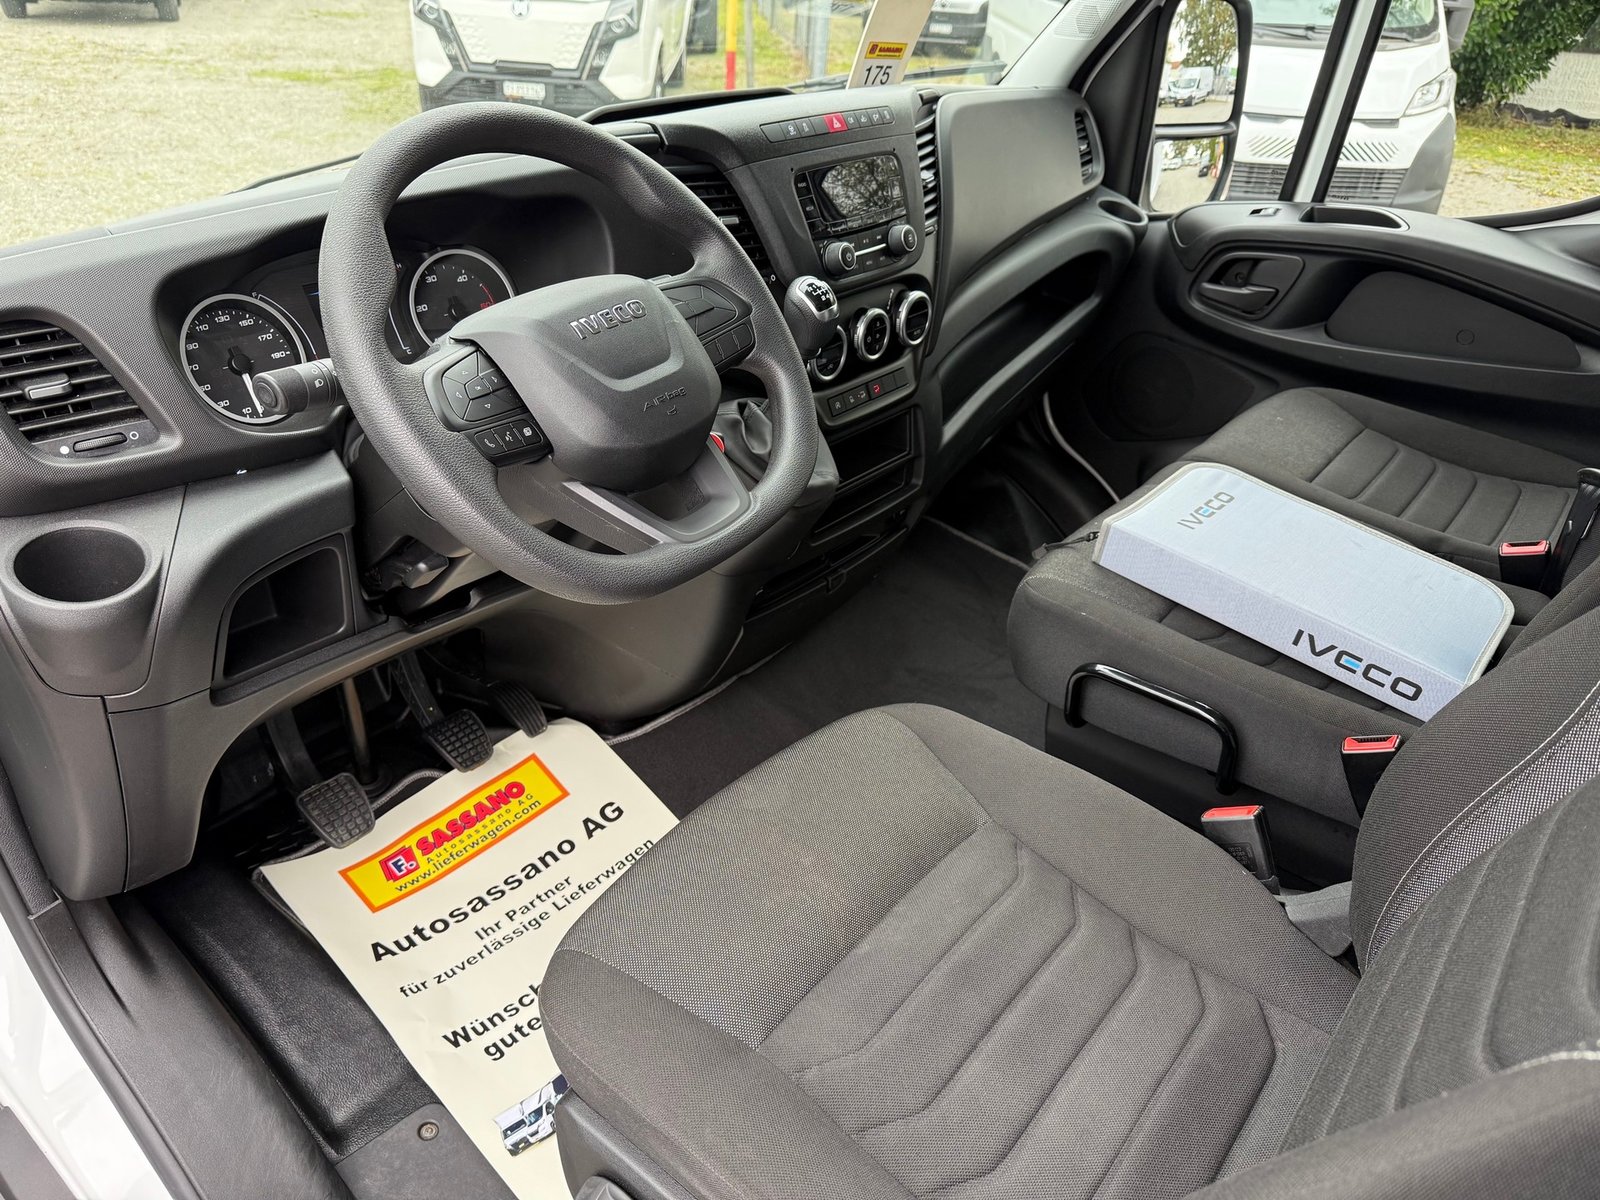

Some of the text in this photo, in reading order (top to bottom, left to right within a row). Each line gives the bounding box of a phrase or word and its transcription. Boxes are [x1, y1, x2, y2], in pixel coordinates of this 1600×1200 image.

[864, 65, 892, 85] 175
[425, 274, 437, 284] 30
[456, 274, 468, 283] 40
[214, 314, 231, 324] 130
[238, 318, 254, 327] 150
[416, 304, 428, 313] 20
[569, 299, 648, 339] IVECO
[195, 323, 209, 332] 110
[257, 333, 273, 343] 170
[186, 342, 199, 351] 90
[242, 407, 252, 415] 10
[1176, 491, 1235, 530] IVECO
[1292, 628, 1424, 702] IVECO
[416, 781, 526, 856] SASSANO
[426, 793, 535, 864] Autosassano AG
[395, 798, 542, 893] www.lieferwagen.com
[370, 801, 625, 962] Autosassano AG
[399, 839, 655, 998] für zuverlässige Lieferwagen
[474, 875, 573, 941] Ihr Partner
[483, 1016, 543, 1061] gute
